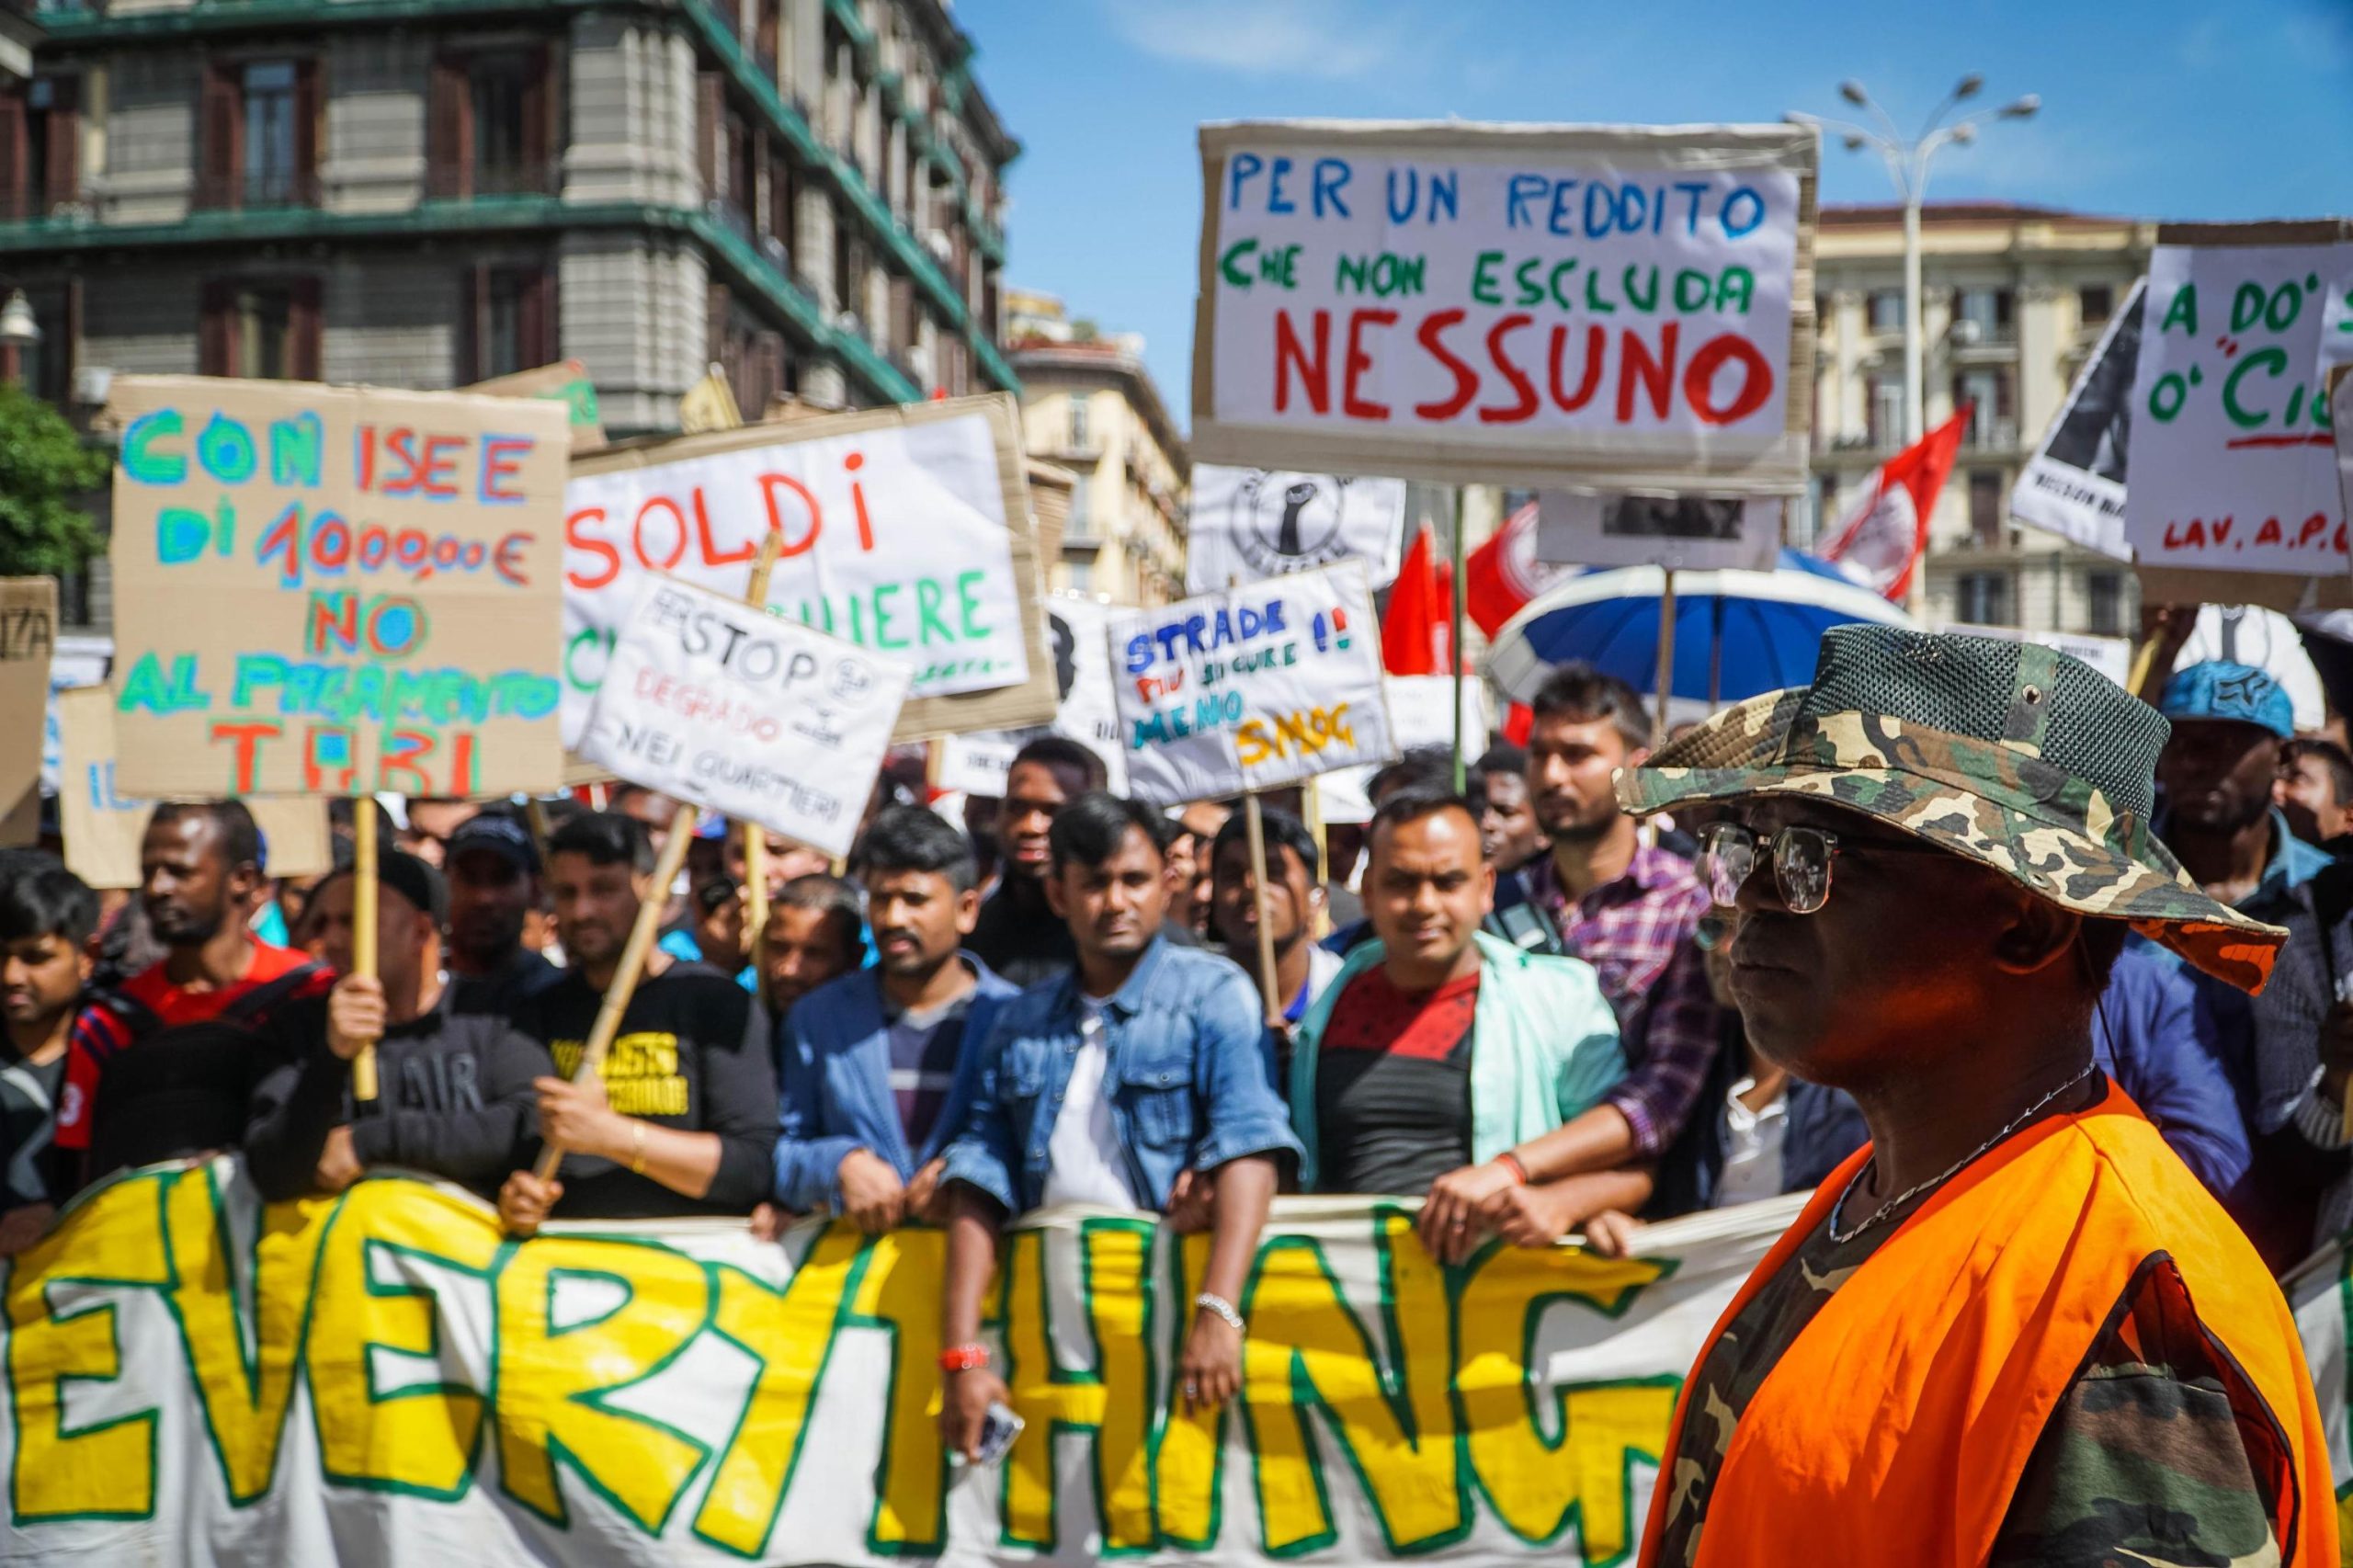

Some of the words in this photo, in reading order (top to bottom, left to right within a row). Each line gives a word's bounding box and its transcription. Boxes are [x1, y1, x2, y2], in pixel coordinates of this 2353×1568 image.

[1230, 152, 1354, 219] PER
[1386, 165, 1460, 226] UN
[1506, 172, 1768, 241] REDDITO
[1220, 237, 1303, 296] CHE
[1335, 250, 1427, 297] NON
[1471, 250, 1755, 315] ESCLUDA
[2161, 282, 2197, 336] A
[1273, 307, 1774, 426] NESSUNO
[120, 407, 324, 487] CON
[355, 426, 538, 505] ISEE
[306, 588, 428, 659] NO
[679, 612, 817, 690] STOP
[1127, 599, 1287, 674] STRADE
[118, 651, 211, 715] AL
[633, 665, 781, 744] DEGRADO
[617, 722, 682, 767] NEI
[1234, 701, 1357, 767] SMOG
[3, 1160, 1682, 1568] EVERYTHING
